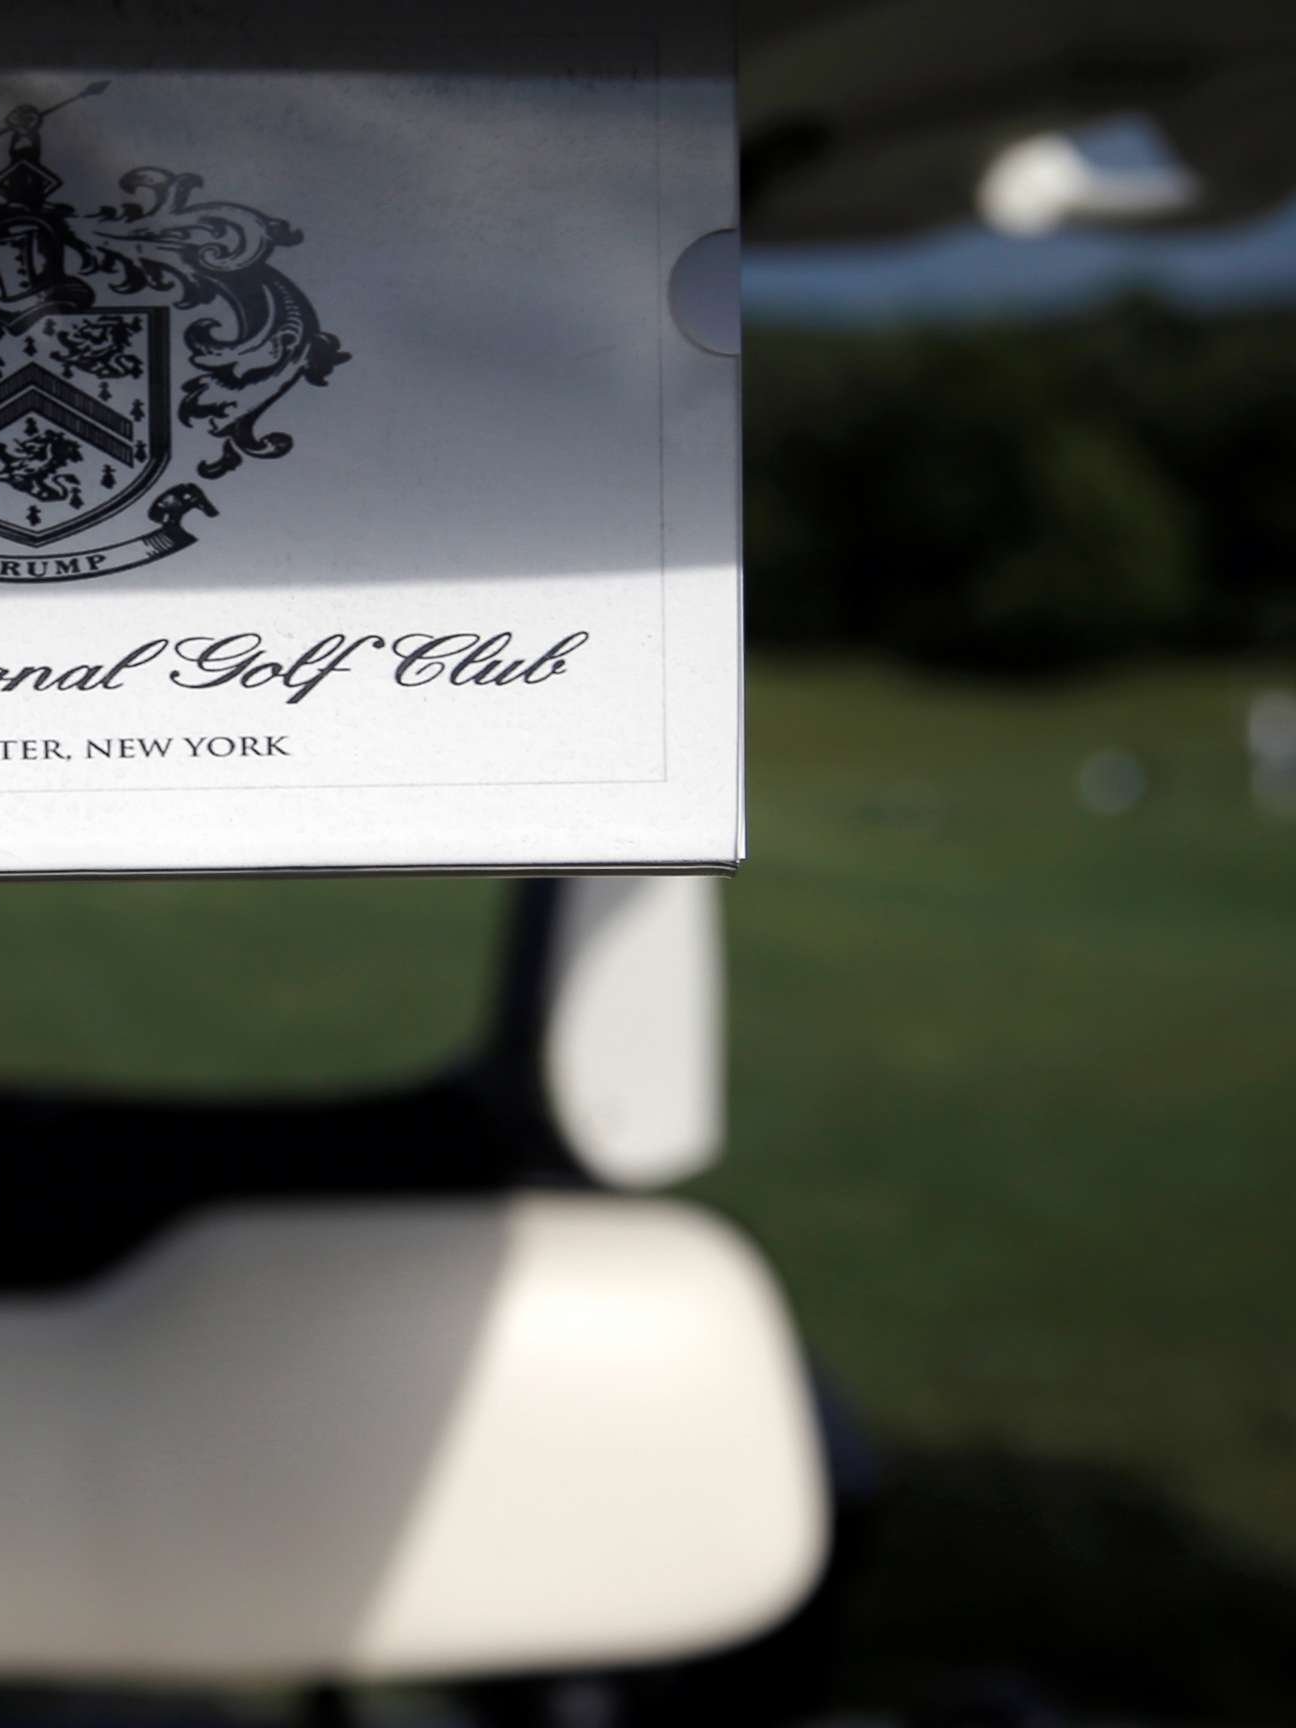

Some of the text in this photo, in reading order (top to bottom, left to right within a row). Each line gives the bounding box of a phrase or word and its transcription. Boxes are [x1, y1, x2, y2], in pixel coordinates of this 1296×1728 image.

[170, 634, 385, 704] Golf
[391, 631, 589, 687] Club
[86, 737, 172, 760] NEW
[183, 735, 289, 757] YORK
